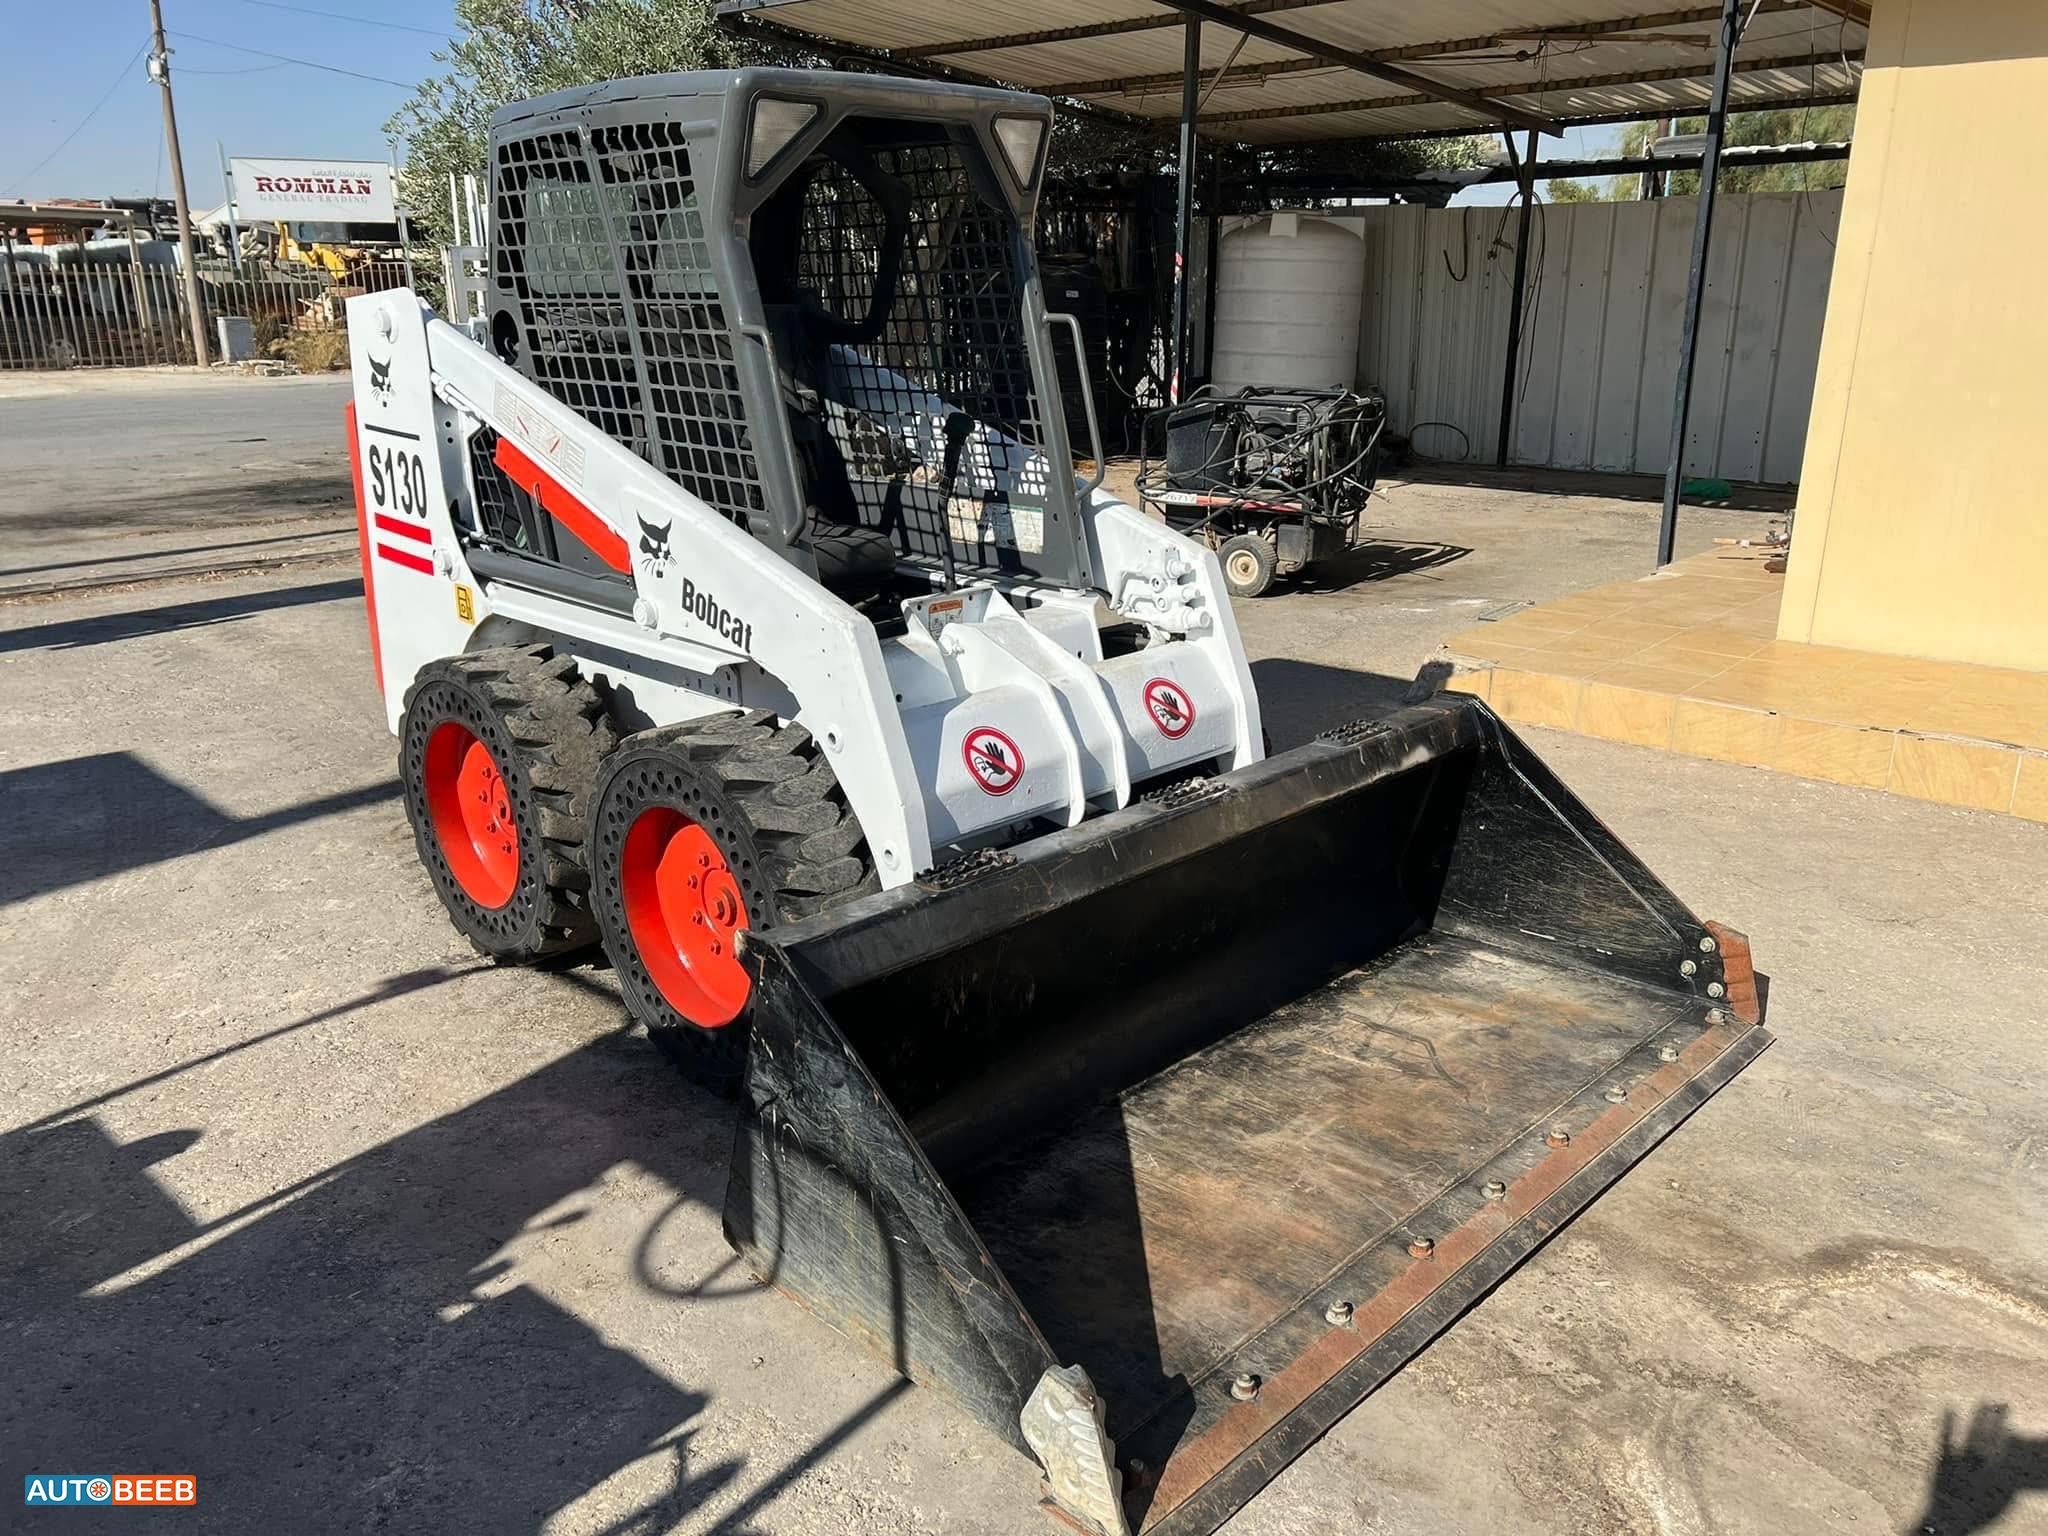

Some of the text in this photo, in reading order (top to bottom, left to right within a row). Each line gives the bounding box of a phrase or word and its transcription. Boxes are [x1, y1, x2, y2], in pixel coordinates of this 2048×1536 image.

[254, 176, 372, 195] ROMMAN
[260, 194, 368, 204] GENERAL TRADING
[369, 444, 427, 519] S130
[682, 576, 753, 654] Bobcat
